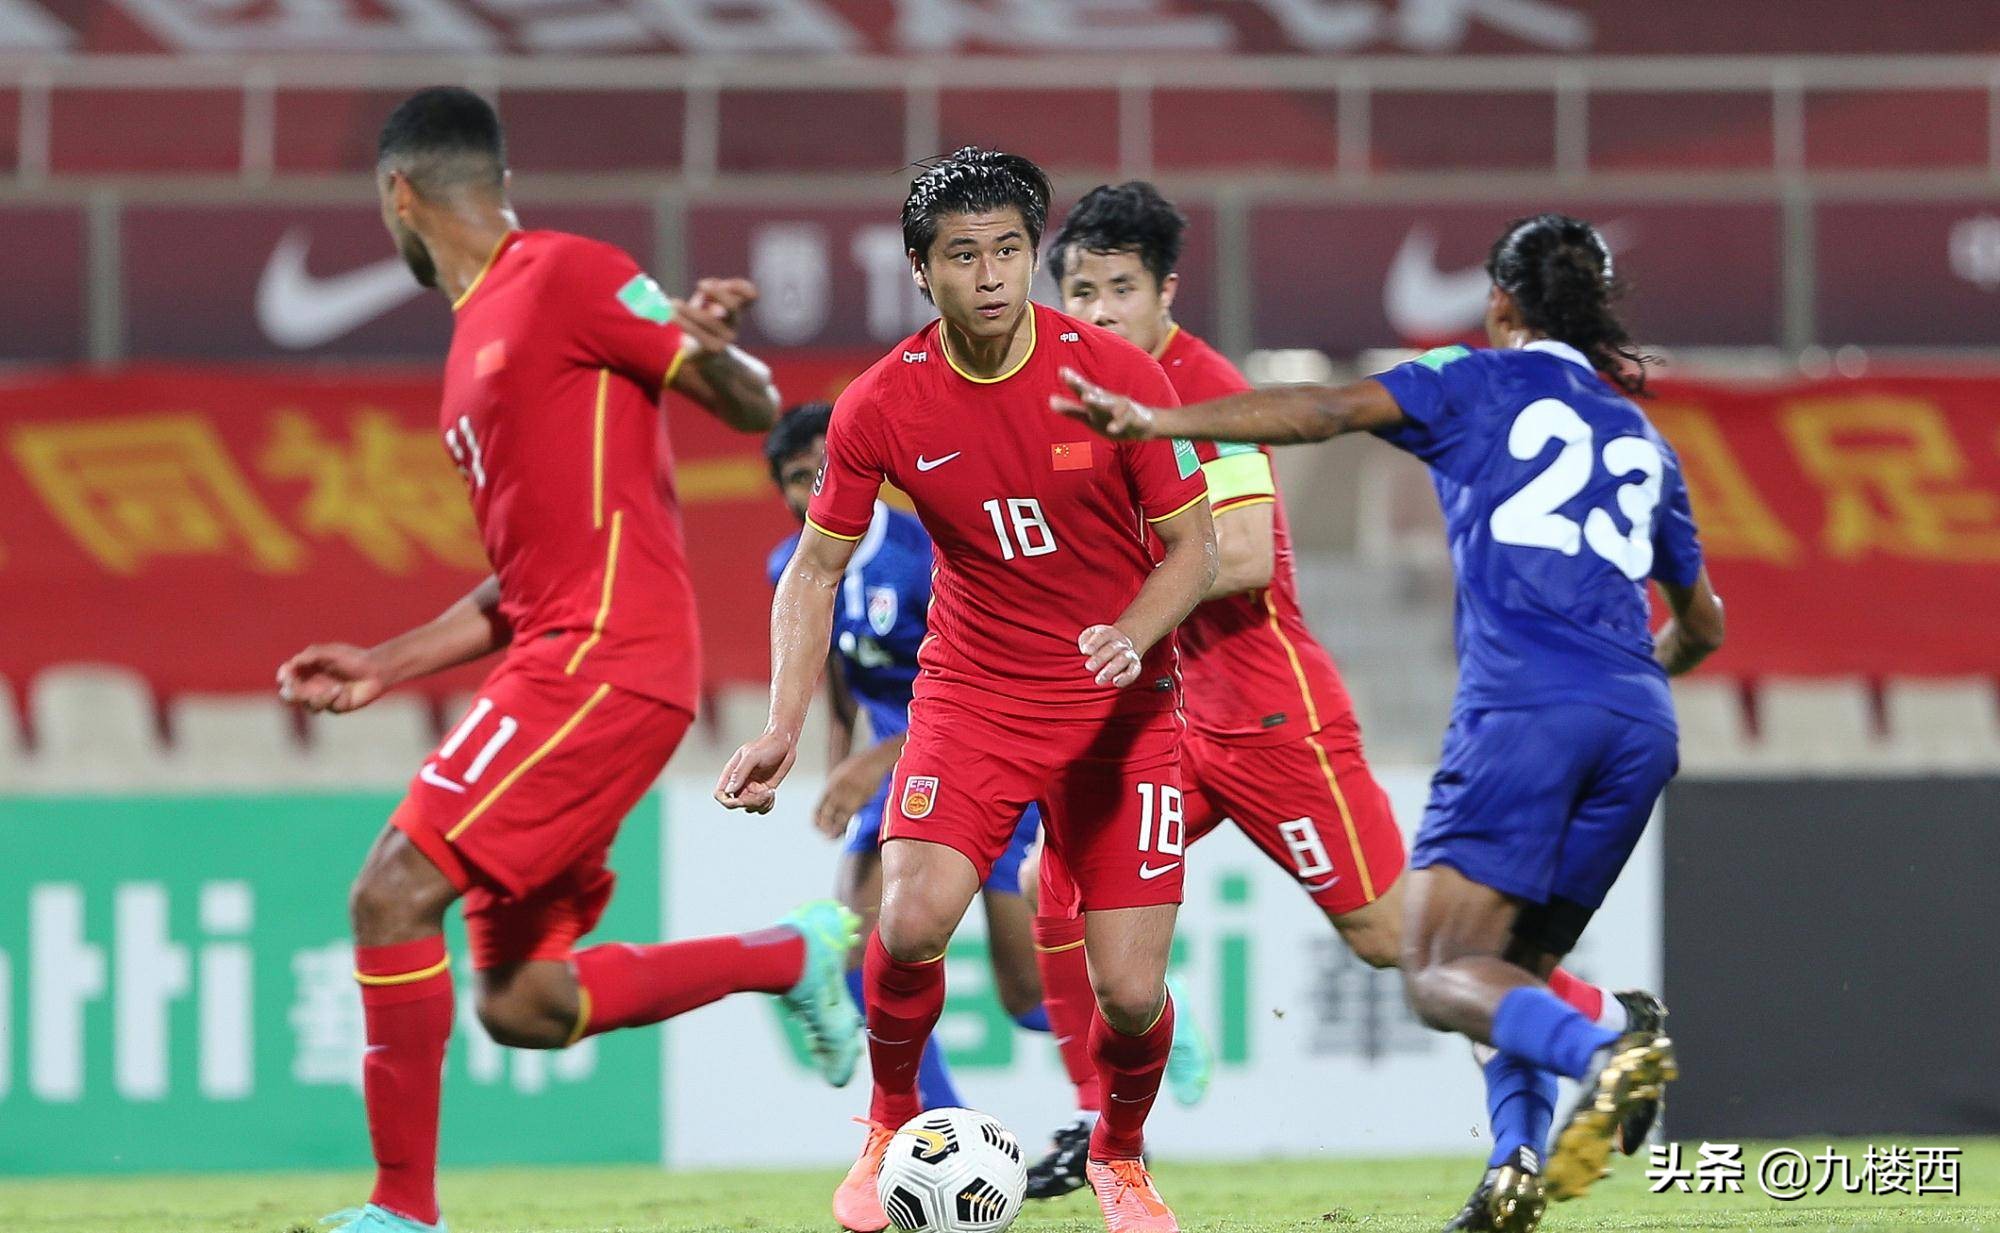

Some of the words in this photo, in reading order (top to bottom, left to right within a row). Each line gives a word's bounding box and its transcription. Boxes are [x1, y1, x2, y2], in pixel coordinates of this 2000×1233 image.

[1490, 398, 1663, 582] 23
[981, 497, 1057, 561] 18
[439, 697, 518, 784] 11
[1137, 783, 1182, 856] 18
[1280, 818, 1332, 877] 8
